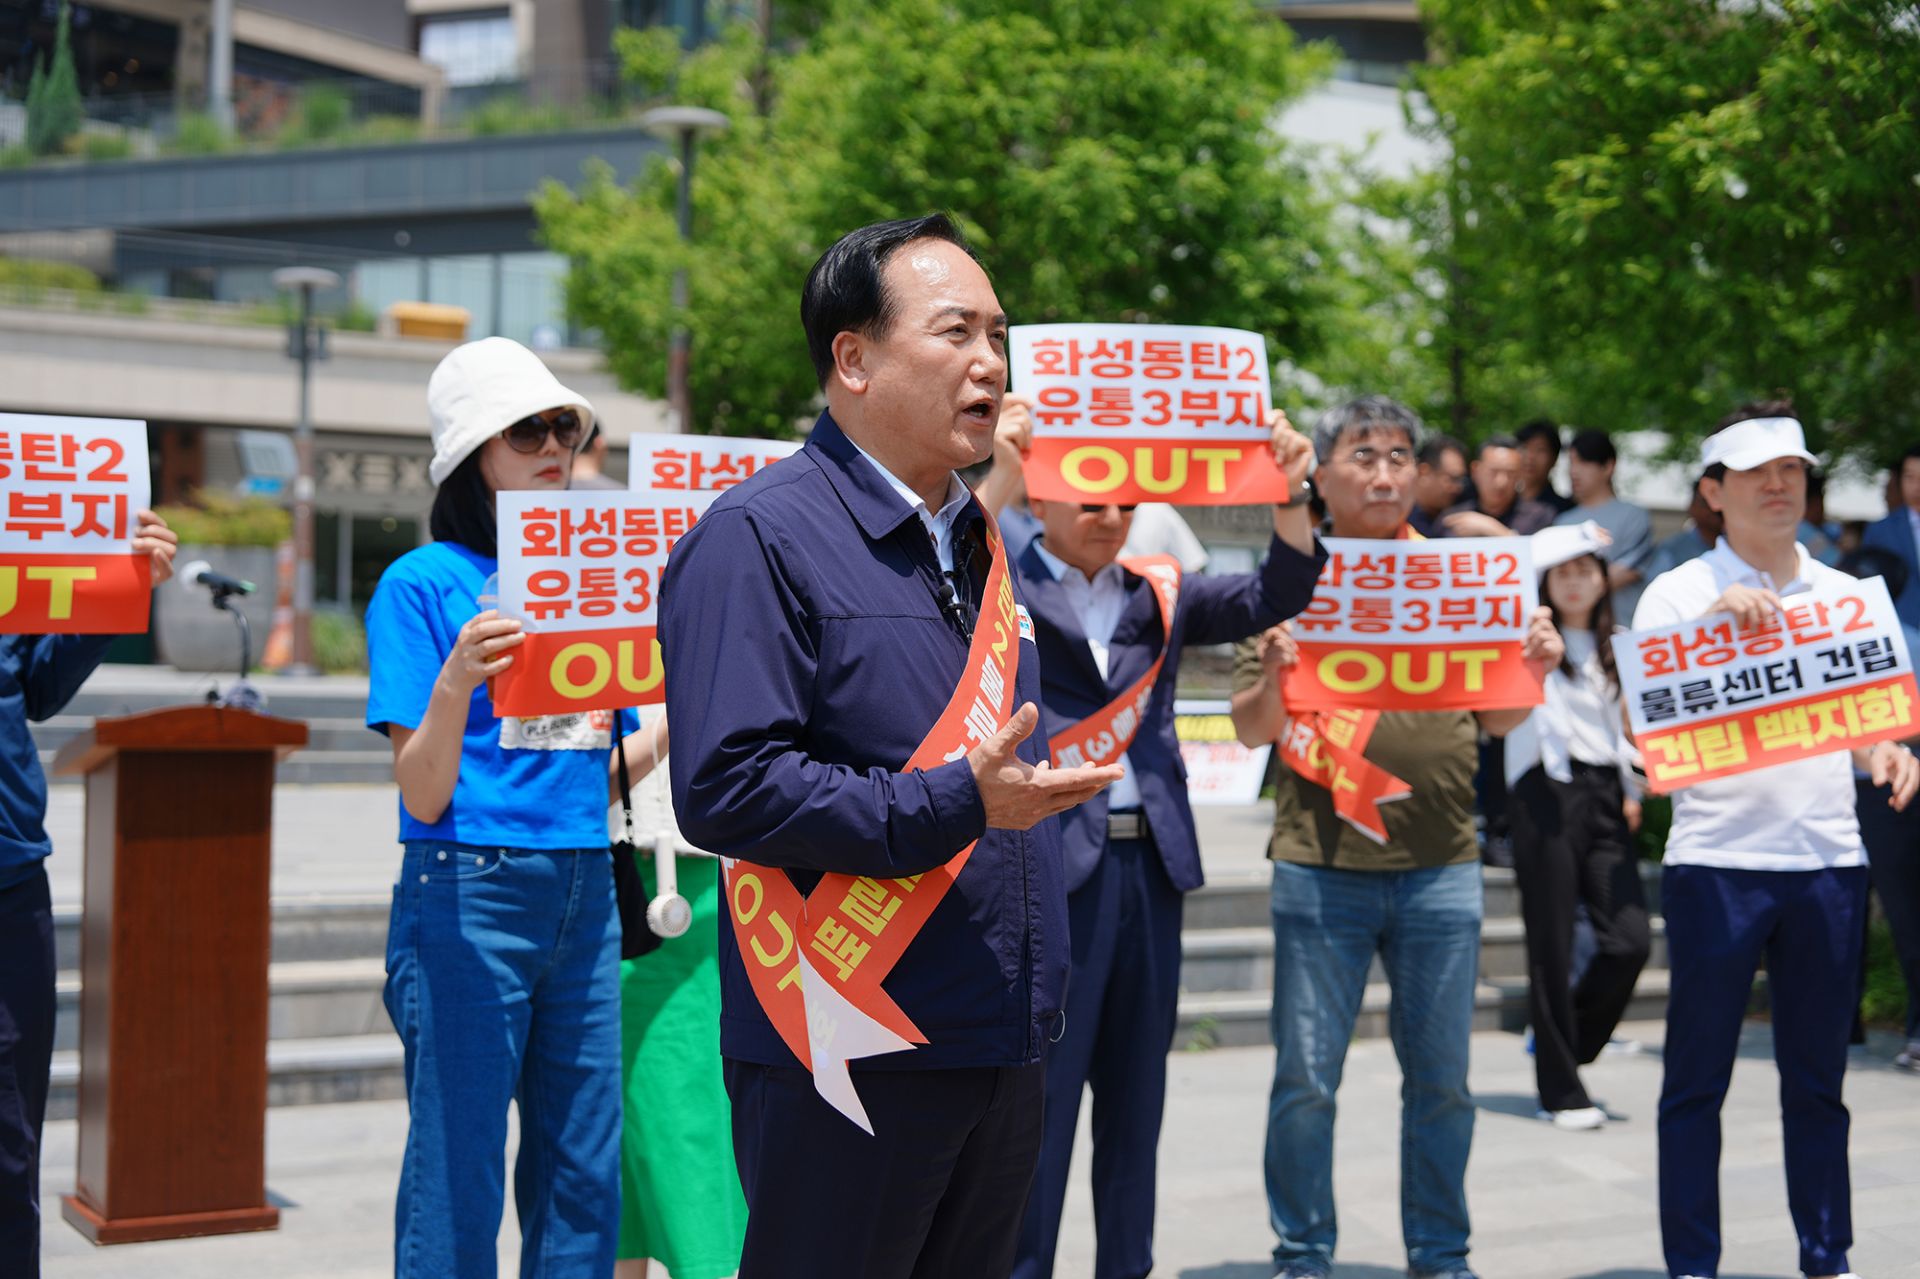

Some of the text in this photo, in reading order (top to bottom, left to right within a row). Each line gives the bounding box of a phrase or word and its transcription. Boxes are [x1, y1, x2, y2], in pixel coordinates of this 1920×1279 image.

[1032, 339, 1260, 381] 화성동탄2
[1036, 386, 1265, 428] 유통3부지
[0, 432, 128, 482] 탄2
[651, 449, 780, 490] 화성
[1060, 446, 1242, 494] OUT
[5, 492, 128, 540] 부지
[524, 566, 664, 619] 유통3
[991, 550, 1015, 668] 탄2
[1296, 595, 1523, 633] 유통3부지
[1637, 595, 1874, 678] 화성동탄2
[1317, 649, 1500, 694] OUT
[1640, 637, 1898, 723] 물류센터 건립
[1646, 682, 1912, 782] 건립 백지화
